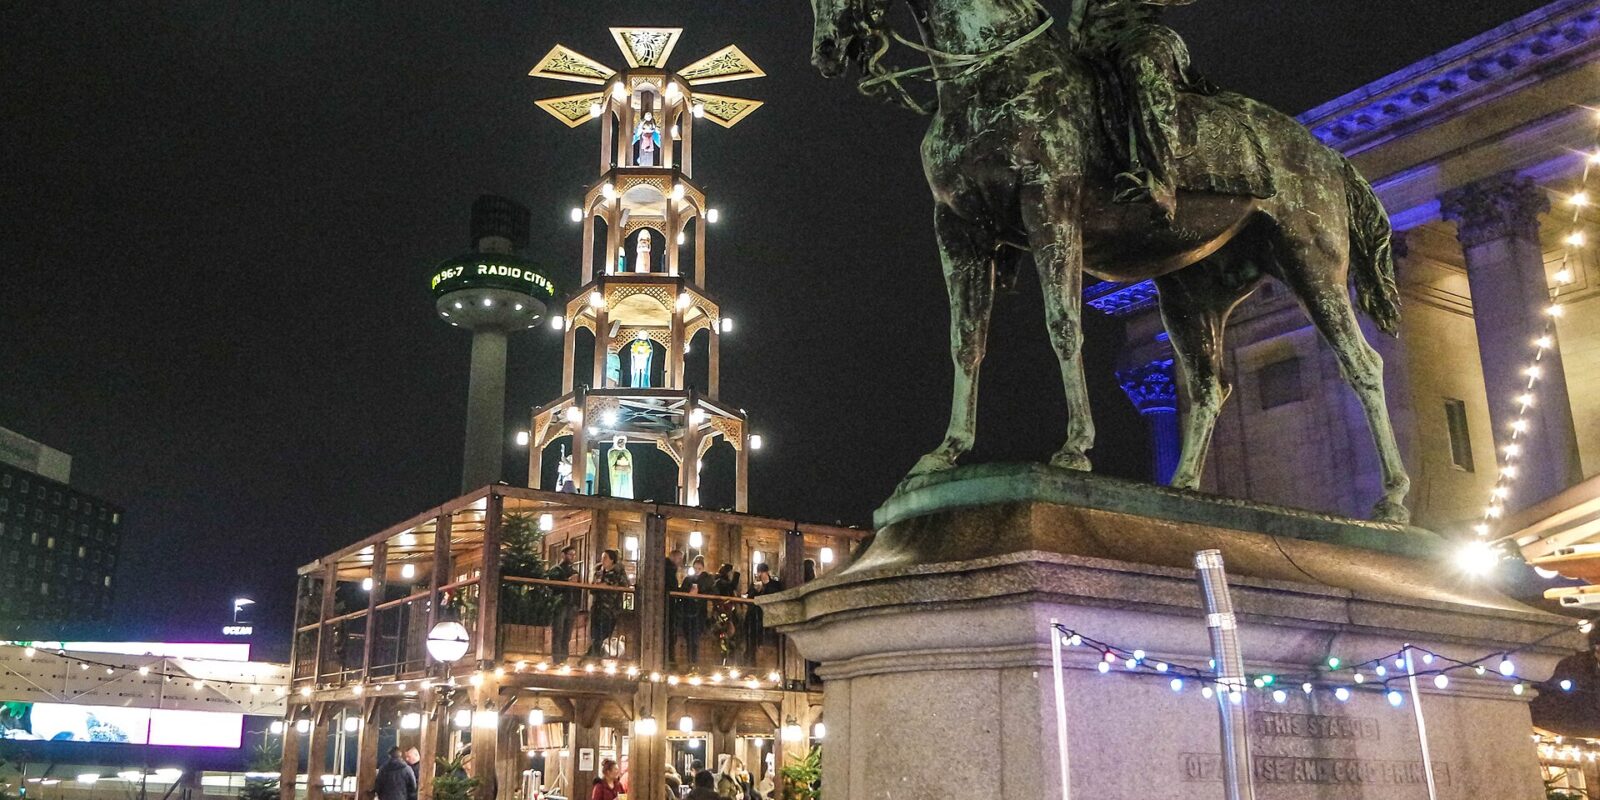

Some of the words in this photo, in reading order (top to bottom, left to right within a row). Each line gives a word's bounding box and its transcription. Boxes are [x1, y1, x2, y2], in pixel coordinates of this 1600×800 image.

[478, 264, 522, 279] RADIO
[524, 271, 546, 287] CITY
[1263, 714, 1301, 736] THIS
[1308, 715, 1374, 738] STATUE
[1255, 758, 1291, 782] ISE
